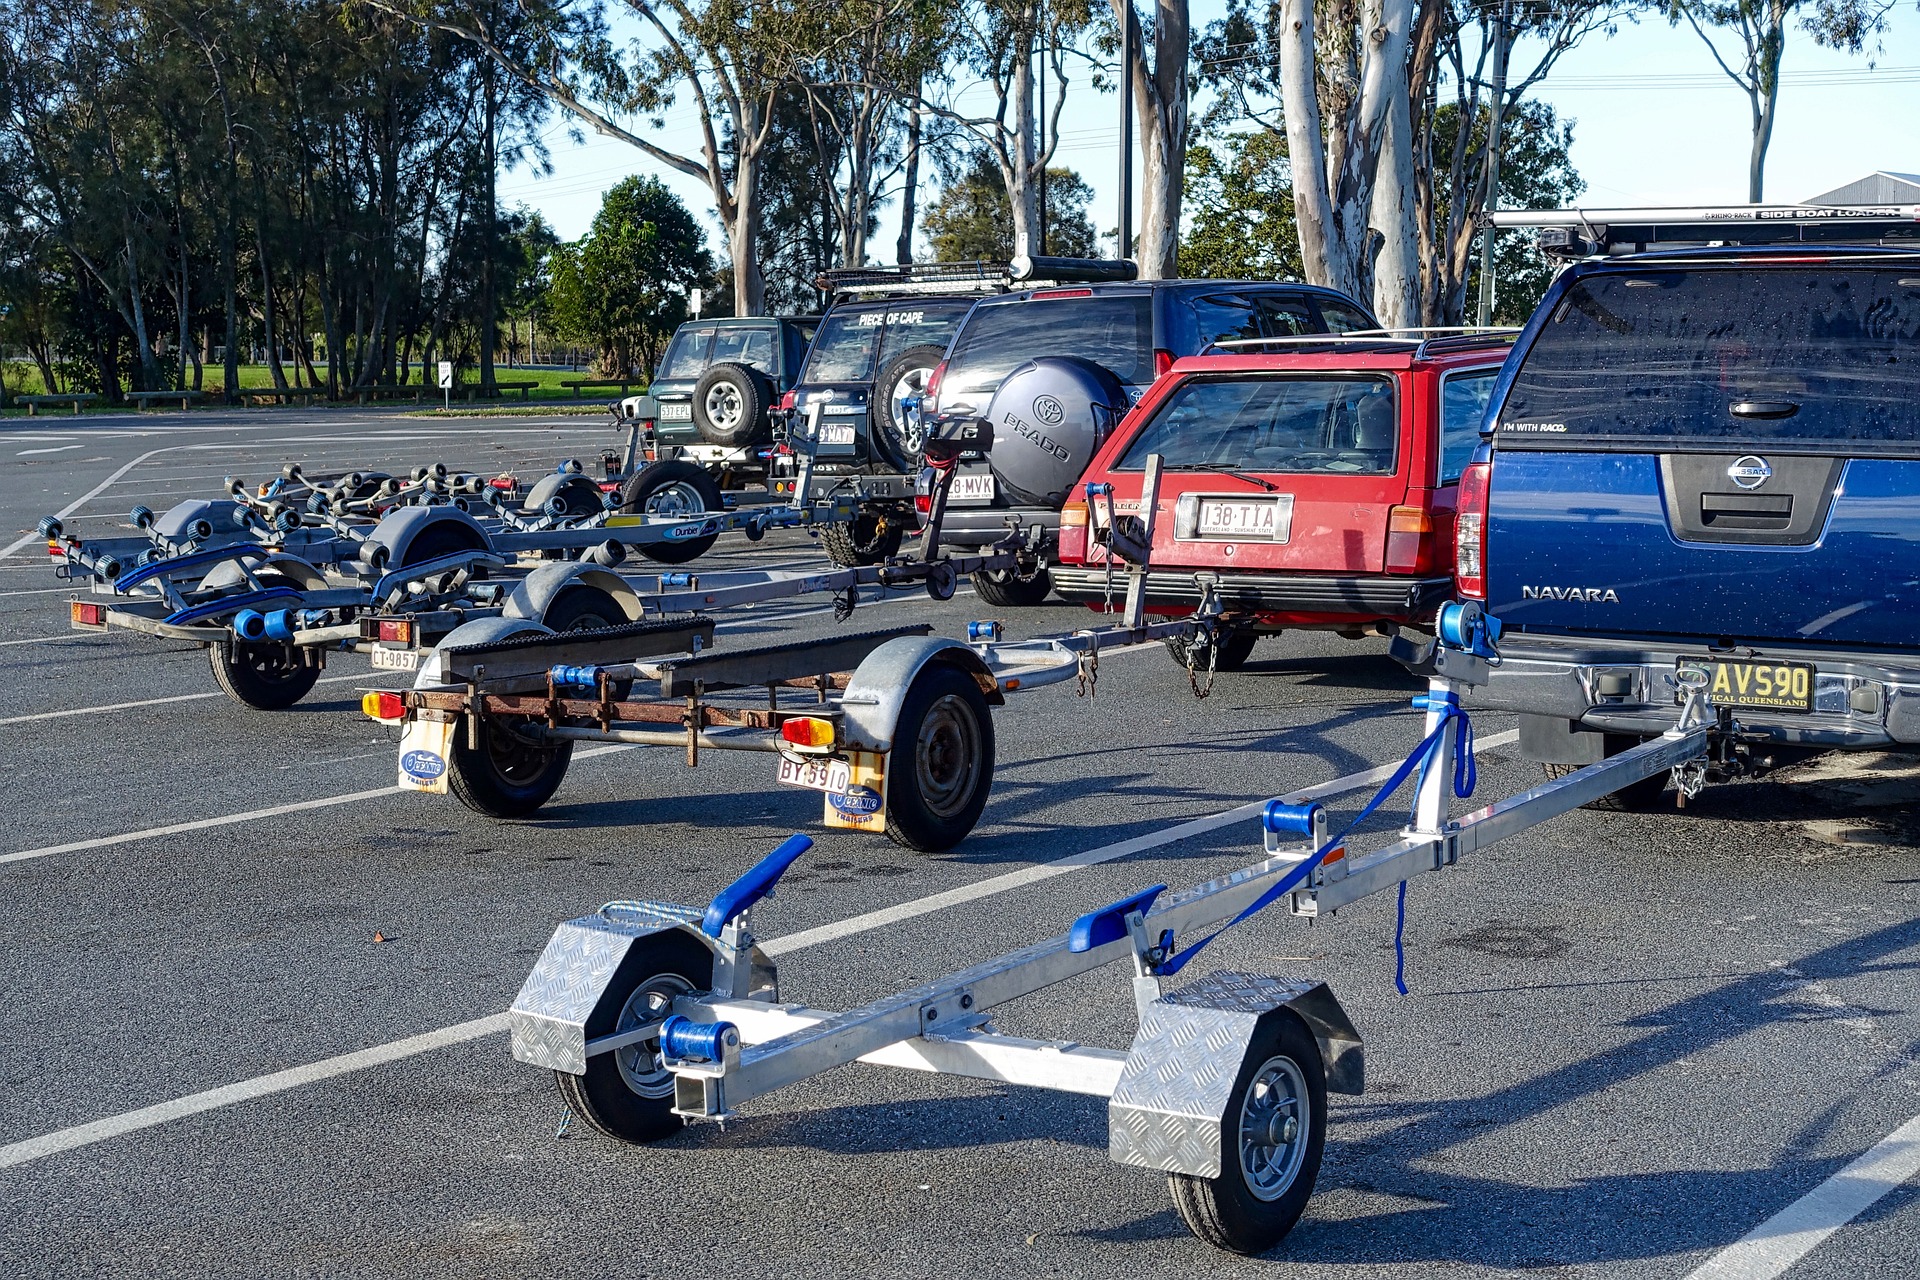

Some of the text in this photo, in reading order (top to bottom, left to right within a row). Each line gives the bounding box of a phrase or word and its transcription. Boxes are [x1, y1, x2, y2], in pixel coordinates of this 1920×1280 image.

[1760, 211, 1793, 219] SIDE
[1796, 209, 1835, 218] BOAT
[859, 311, 924, 326] PIECE OF CAPE
[1503, 423, 1567, 433] I'M WITH RACQ
[1003, 411, 1071, 463] PRADO
[949, 477, 991, 494] 8·MVK
[1099, 502, 1140, 510] FLCON
[675, 525, 698, 537] Dunbier
[1522, 585, 1620, 604] NAVARA
[1712, 663, 1809, 699] AVS90
[1709, 694, 1808, 708] ICAL QUEENSLAND
[834, 793, 878, 811] OCEANIC
[835, 810, 874, 824] TRAILERS
